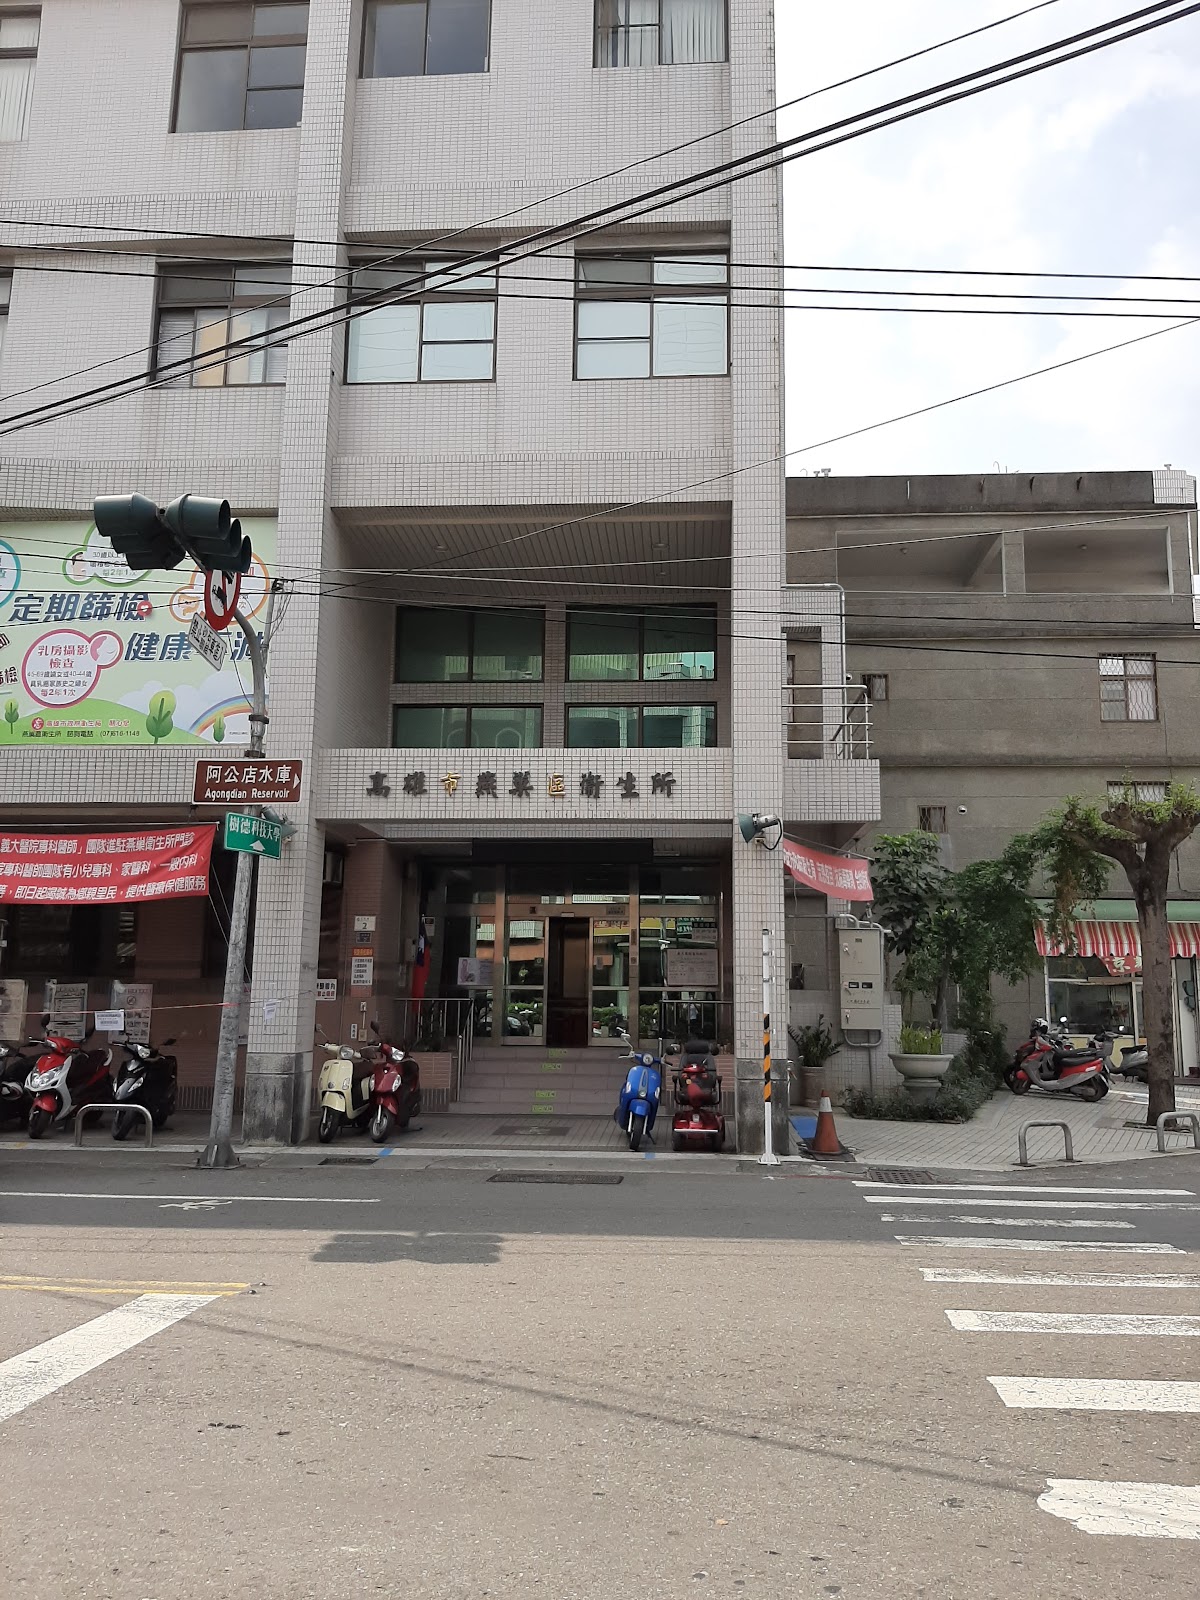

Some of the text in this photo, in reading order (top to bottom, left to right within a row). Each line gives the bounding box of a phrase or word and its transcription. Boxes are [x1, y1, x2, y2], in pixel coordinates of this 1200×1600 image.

[7, 593, 149, 622] 定期篩檢
[37, 645, 89, 656] 乳房攝影
[49, 658, 75, 669] 檢查
[40, 689, 77, 697] 每2年1次
[206, 765, 292, 784] 阿公店水庫
[205, 788, 290, 801] Agongdian Reservoir
[229, 816, 281, 842] 樹德科技大學
